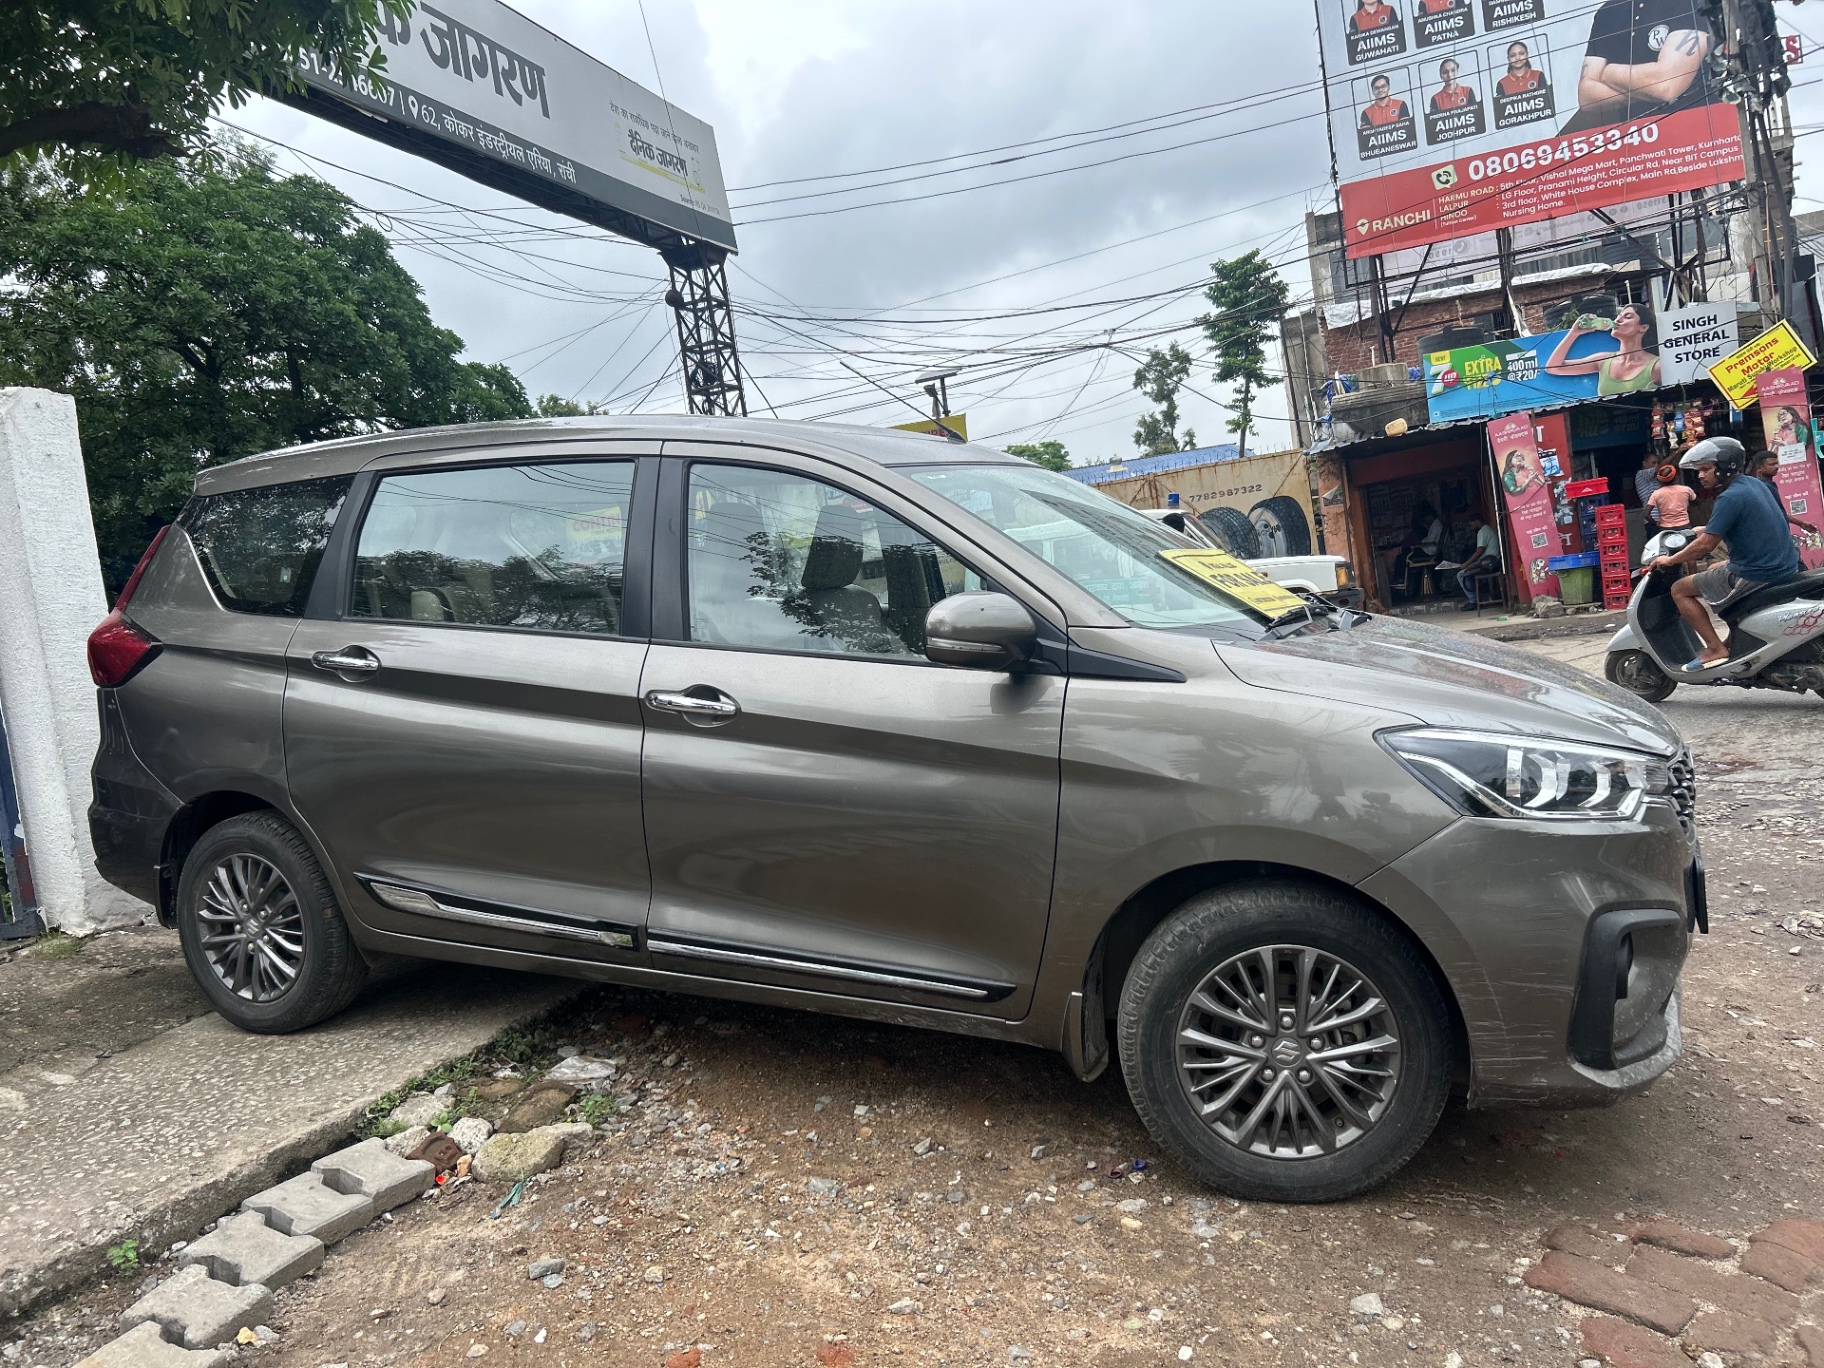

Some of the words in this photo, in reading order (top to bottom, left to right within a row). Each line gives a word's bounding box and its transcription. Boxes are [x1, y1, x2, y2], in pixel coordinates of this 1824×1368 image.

[1493, 1, 1533, 18] AIIMS
[1424, 16, 1464, 35] AIIMS
[1492, 11, 1536, 28] RISHIKESH
[1357, 33, 1396, 52] AIIMS
[1431, 30, 1460, 43] PATNA
[420, 0, 551, 120] जागरण
[1355, 45, 1399, 61] GUWAHATI
[1504, 97, 1545, 116] AIIMS
[442, 111, 475, 142] कोकर
[1435, 114, 1475, 132] AIIMS
[1499, 109, 1552, 127] GORAKHPUR
[1368, 130, 1407, 147] AIIMS
[1436, 126, 1476, 142] JODHPUR
[628, 128, 655, 162] दैनिक
[655, 147, 688, 176] जागरण
[1468, 123, 1659, 181] 08069453340
[1438, 191, 1469, 205] HARMU
[1470, 186, 1494, 198] ROAD
[1500, 181, 1513, 191] 5th
[1540, 171, 1567, 183] Vishal
[1568, 165, 1594, 179] Mega
[1595, 159, 1619, 172] Mart,
[1619, 149, 1666, 165] Panchwati
[1668, 144, 1697, 157] Tower,
[1439, 200, 1469, 213] LALPUR
[1501, 191, 1512, 201] LG
[1513, 187, 1537, 199] Floor,
[1538, 179, 1575, 192] Pranami
[1576, 172, 1608, 187] Height,
[1609, 164, 1646, 178] Circular
[1647, 160, 1660, 171] Rd,
[1662, 157, 1684, 168] Near
[1685, 153, 1699, 163] BIT
[1700, 145, 1739, 161] Campus
[1502, 200, 1517, 210] 3rd
[1518, 197, 1540, 209] floor,
[1541, 190, 1567, 202] White
[1568, 184, 1595, 197] House
[1640, 169, 1664, 182] Main
[1502, 206, 1537, 220] Nursing
[1538, 200, 1565, 213] Home.
[1372, 209, 1431, 232] RANCHI
[1673, 314, 1718, 332] SINGH
[1664, 330, 1729, 349] GENERAL
[1675, 347, 1720, 364] STORE
[1725, 337, 1779, 374] Premsons
[1741, 351, 1775, 376] Motor
[1465, 356, 1502, 376] EXTRA
[1189, 484, 1262, 502] 7782987322
